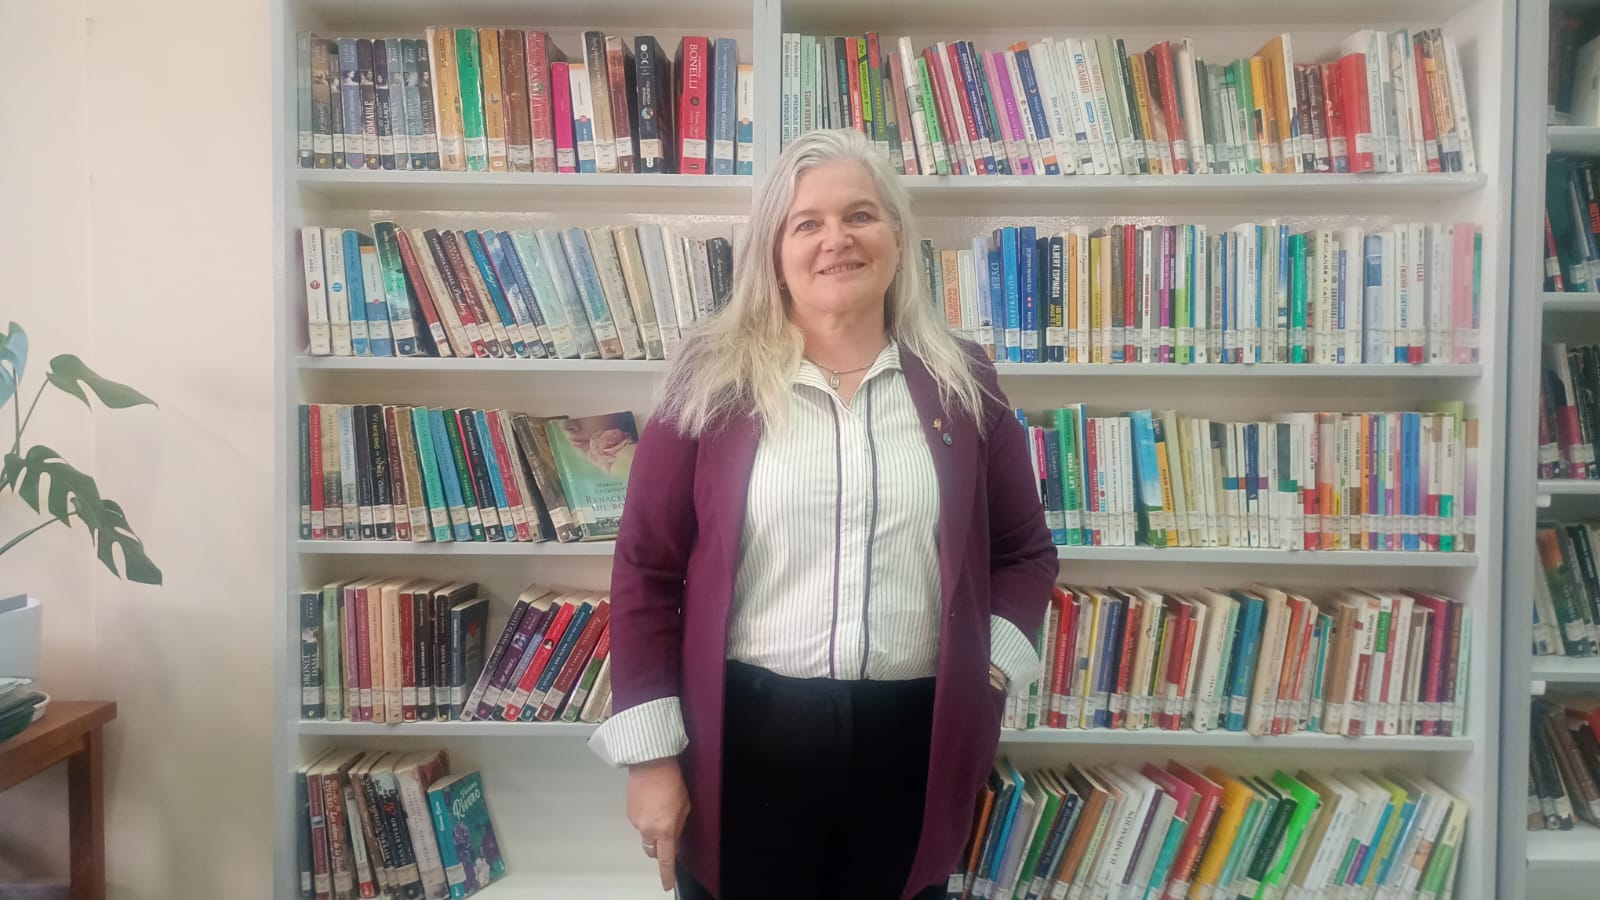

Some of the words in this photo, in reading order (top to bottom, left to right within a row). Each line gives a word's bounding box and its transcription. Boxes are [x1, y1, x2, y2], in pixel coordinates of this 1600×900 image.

[688, 44, 697, 88] BONELLI
[364, 100, 376, 136] DOMABLE
[1051, 244, 1059, 266] ALBERT
[990, 262, 1000, 289] DYER
[1051, 269, 1059, 297] ESPINOSA
[1399, 293, 1407, 328] SENTIMIENTO
[452, 787, 481, 820] Rivero
